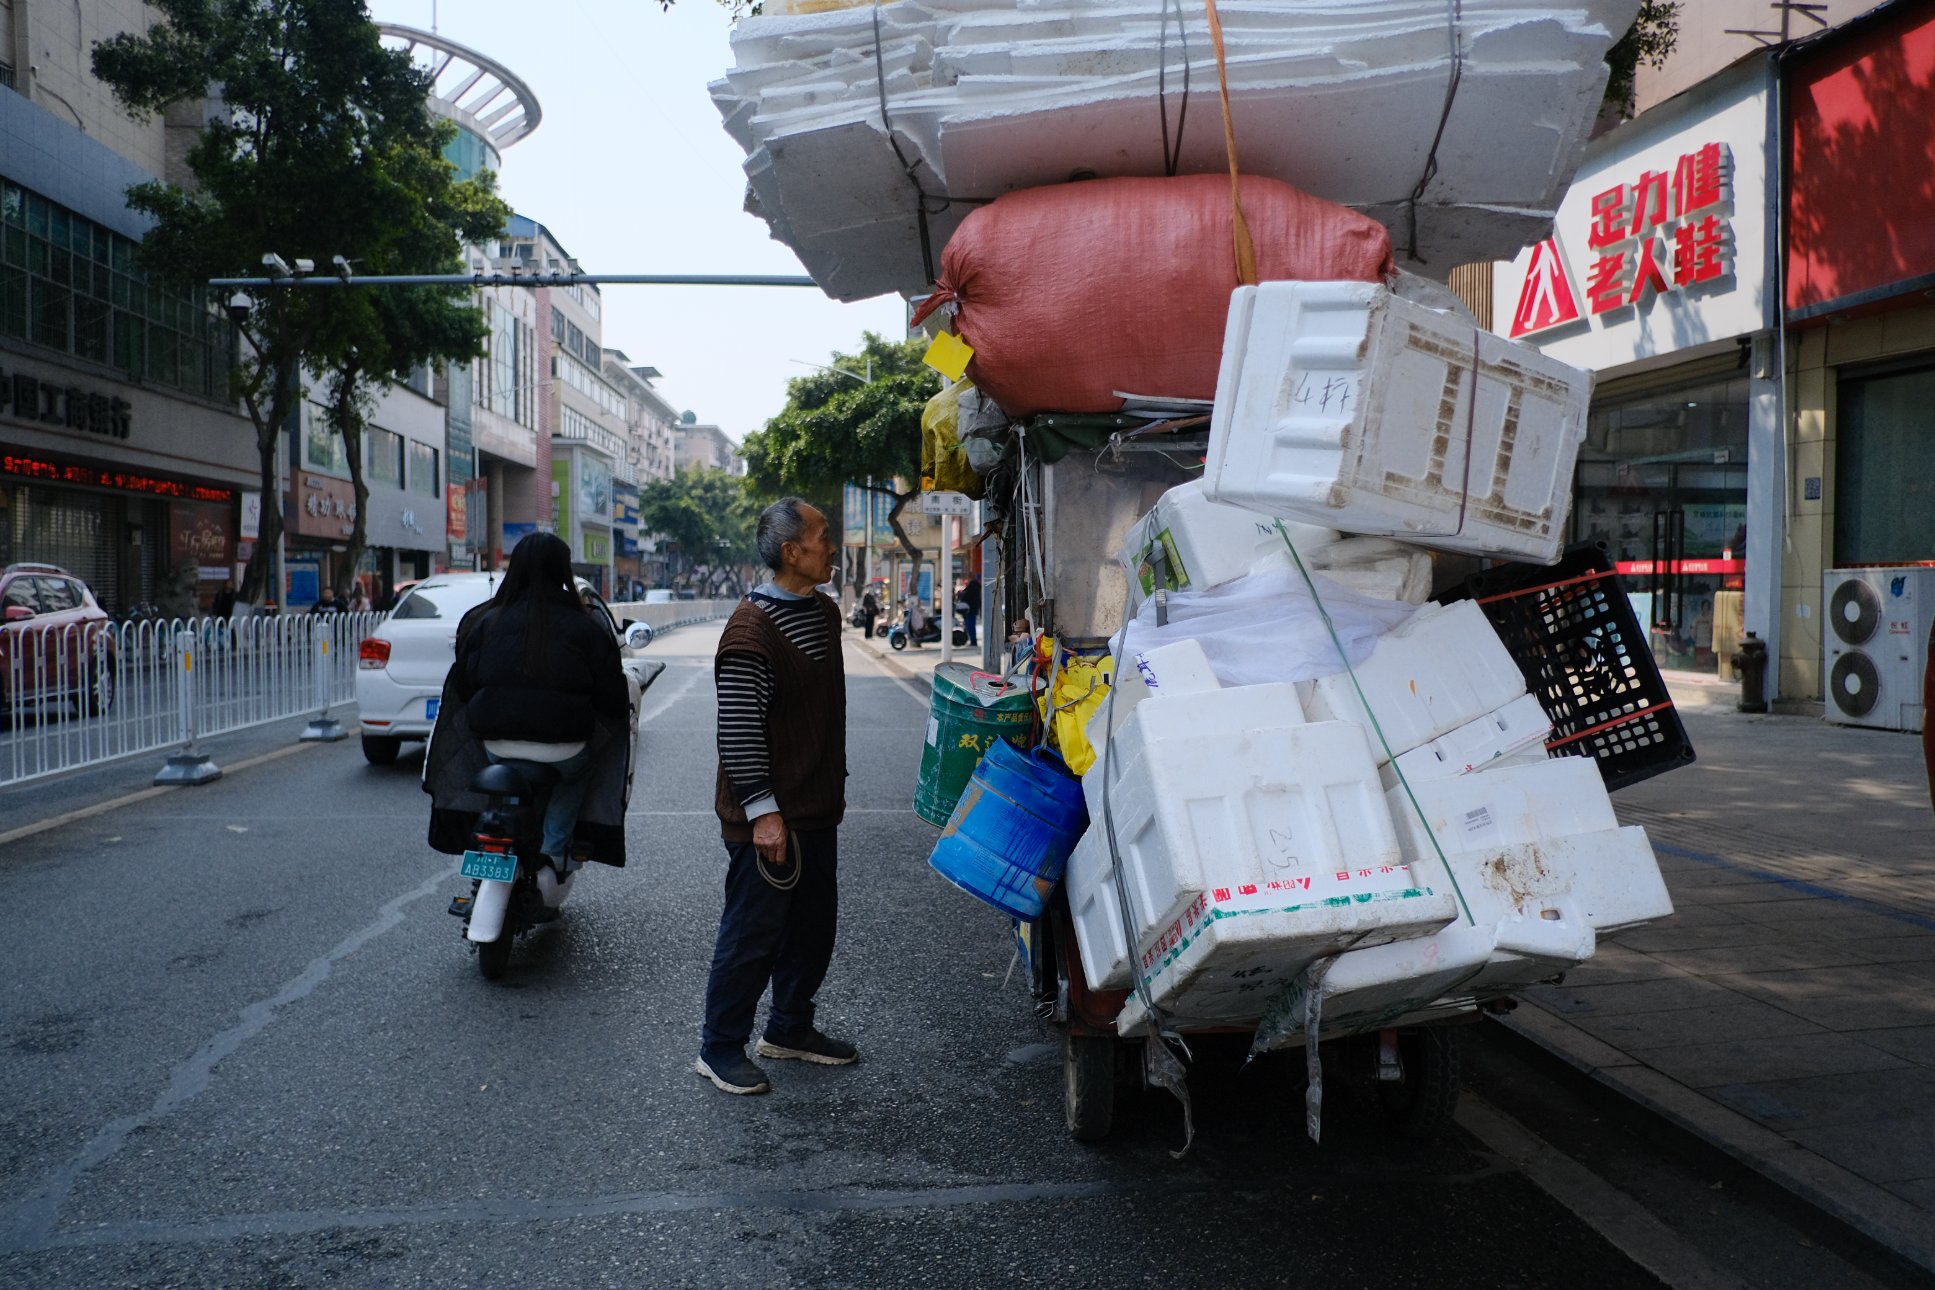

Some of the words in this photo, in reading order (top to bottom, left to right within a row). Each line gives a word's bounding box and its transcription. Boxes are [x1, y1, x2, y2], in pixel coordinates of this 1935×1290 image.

[1588, 142, 1727, 250] 足力健
[1587, 214, 1727, 315] 老人鞋
